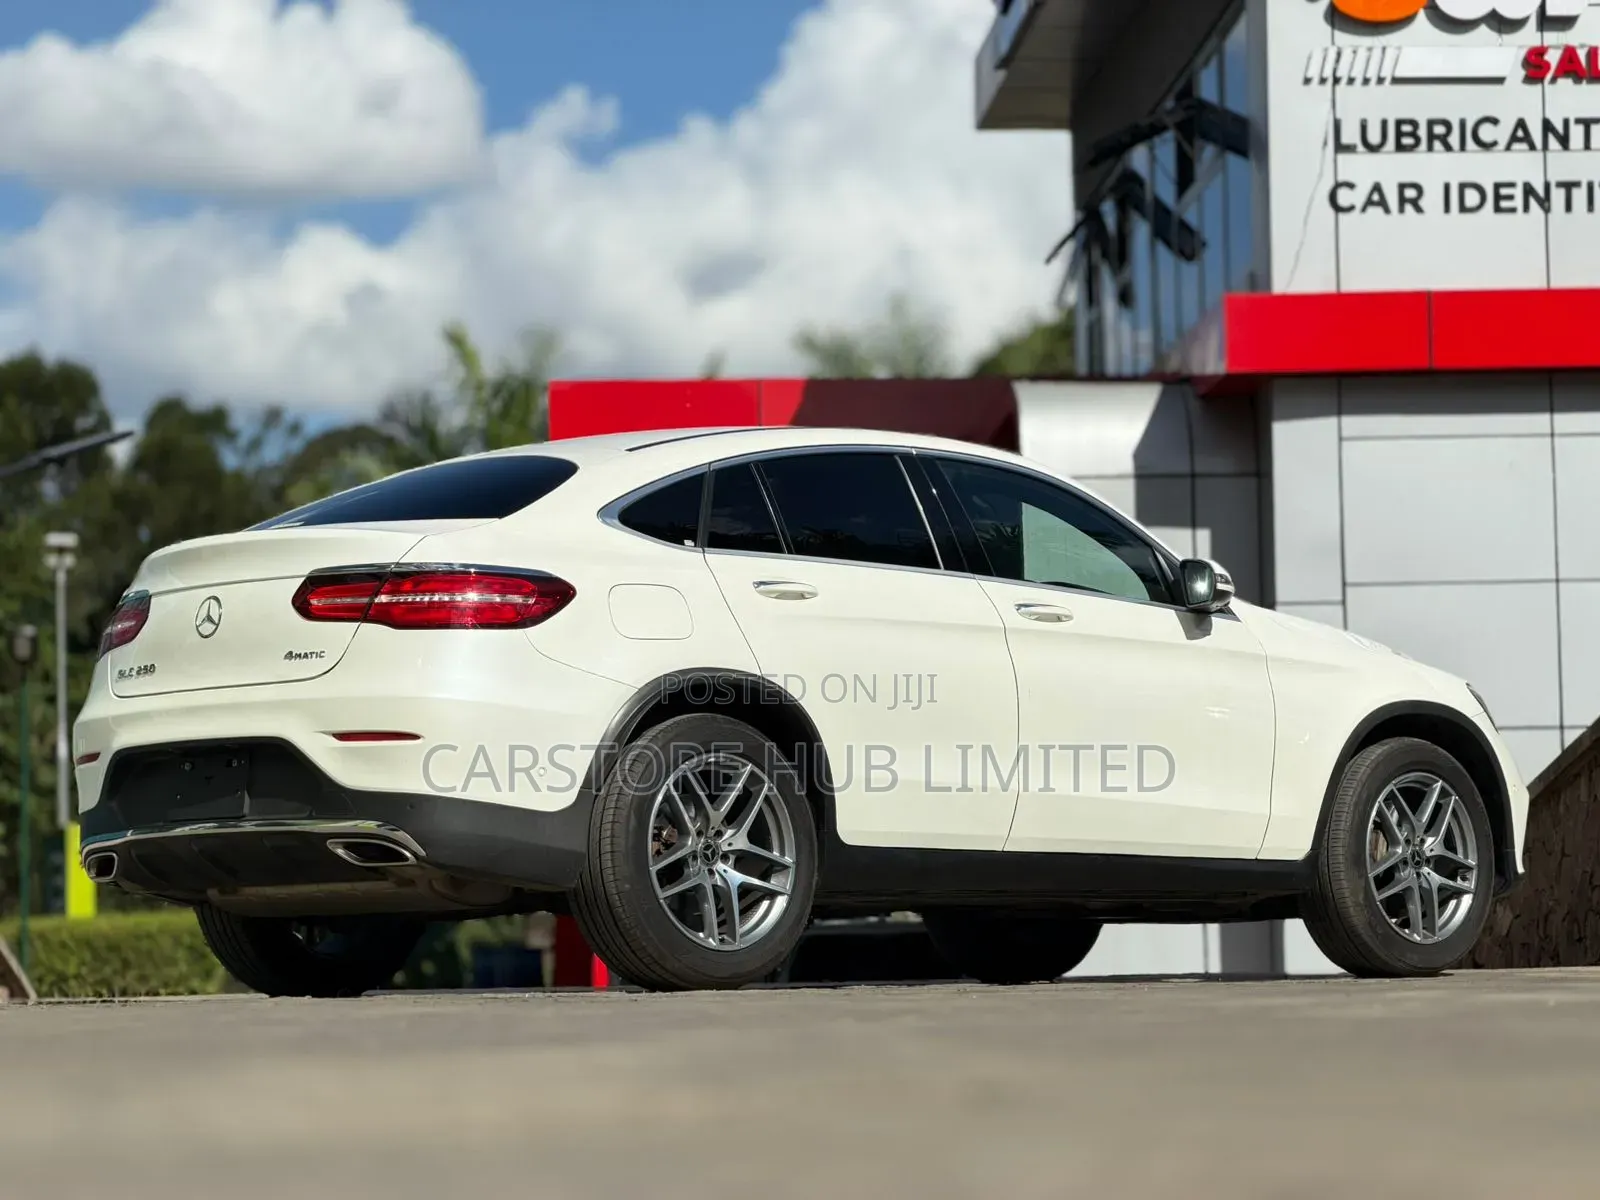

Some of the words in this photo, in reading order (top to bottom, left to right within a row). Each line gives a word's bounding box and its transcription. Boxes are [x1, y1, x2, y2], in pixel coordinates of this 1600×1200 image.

[1335, 116, 1600, 151] LUBRICANT
[1328, 181, 1425, 215] CAR
[1444, 180, 1600, 214] IDENTI
[283, 650, 326, 661] 4MATIC
